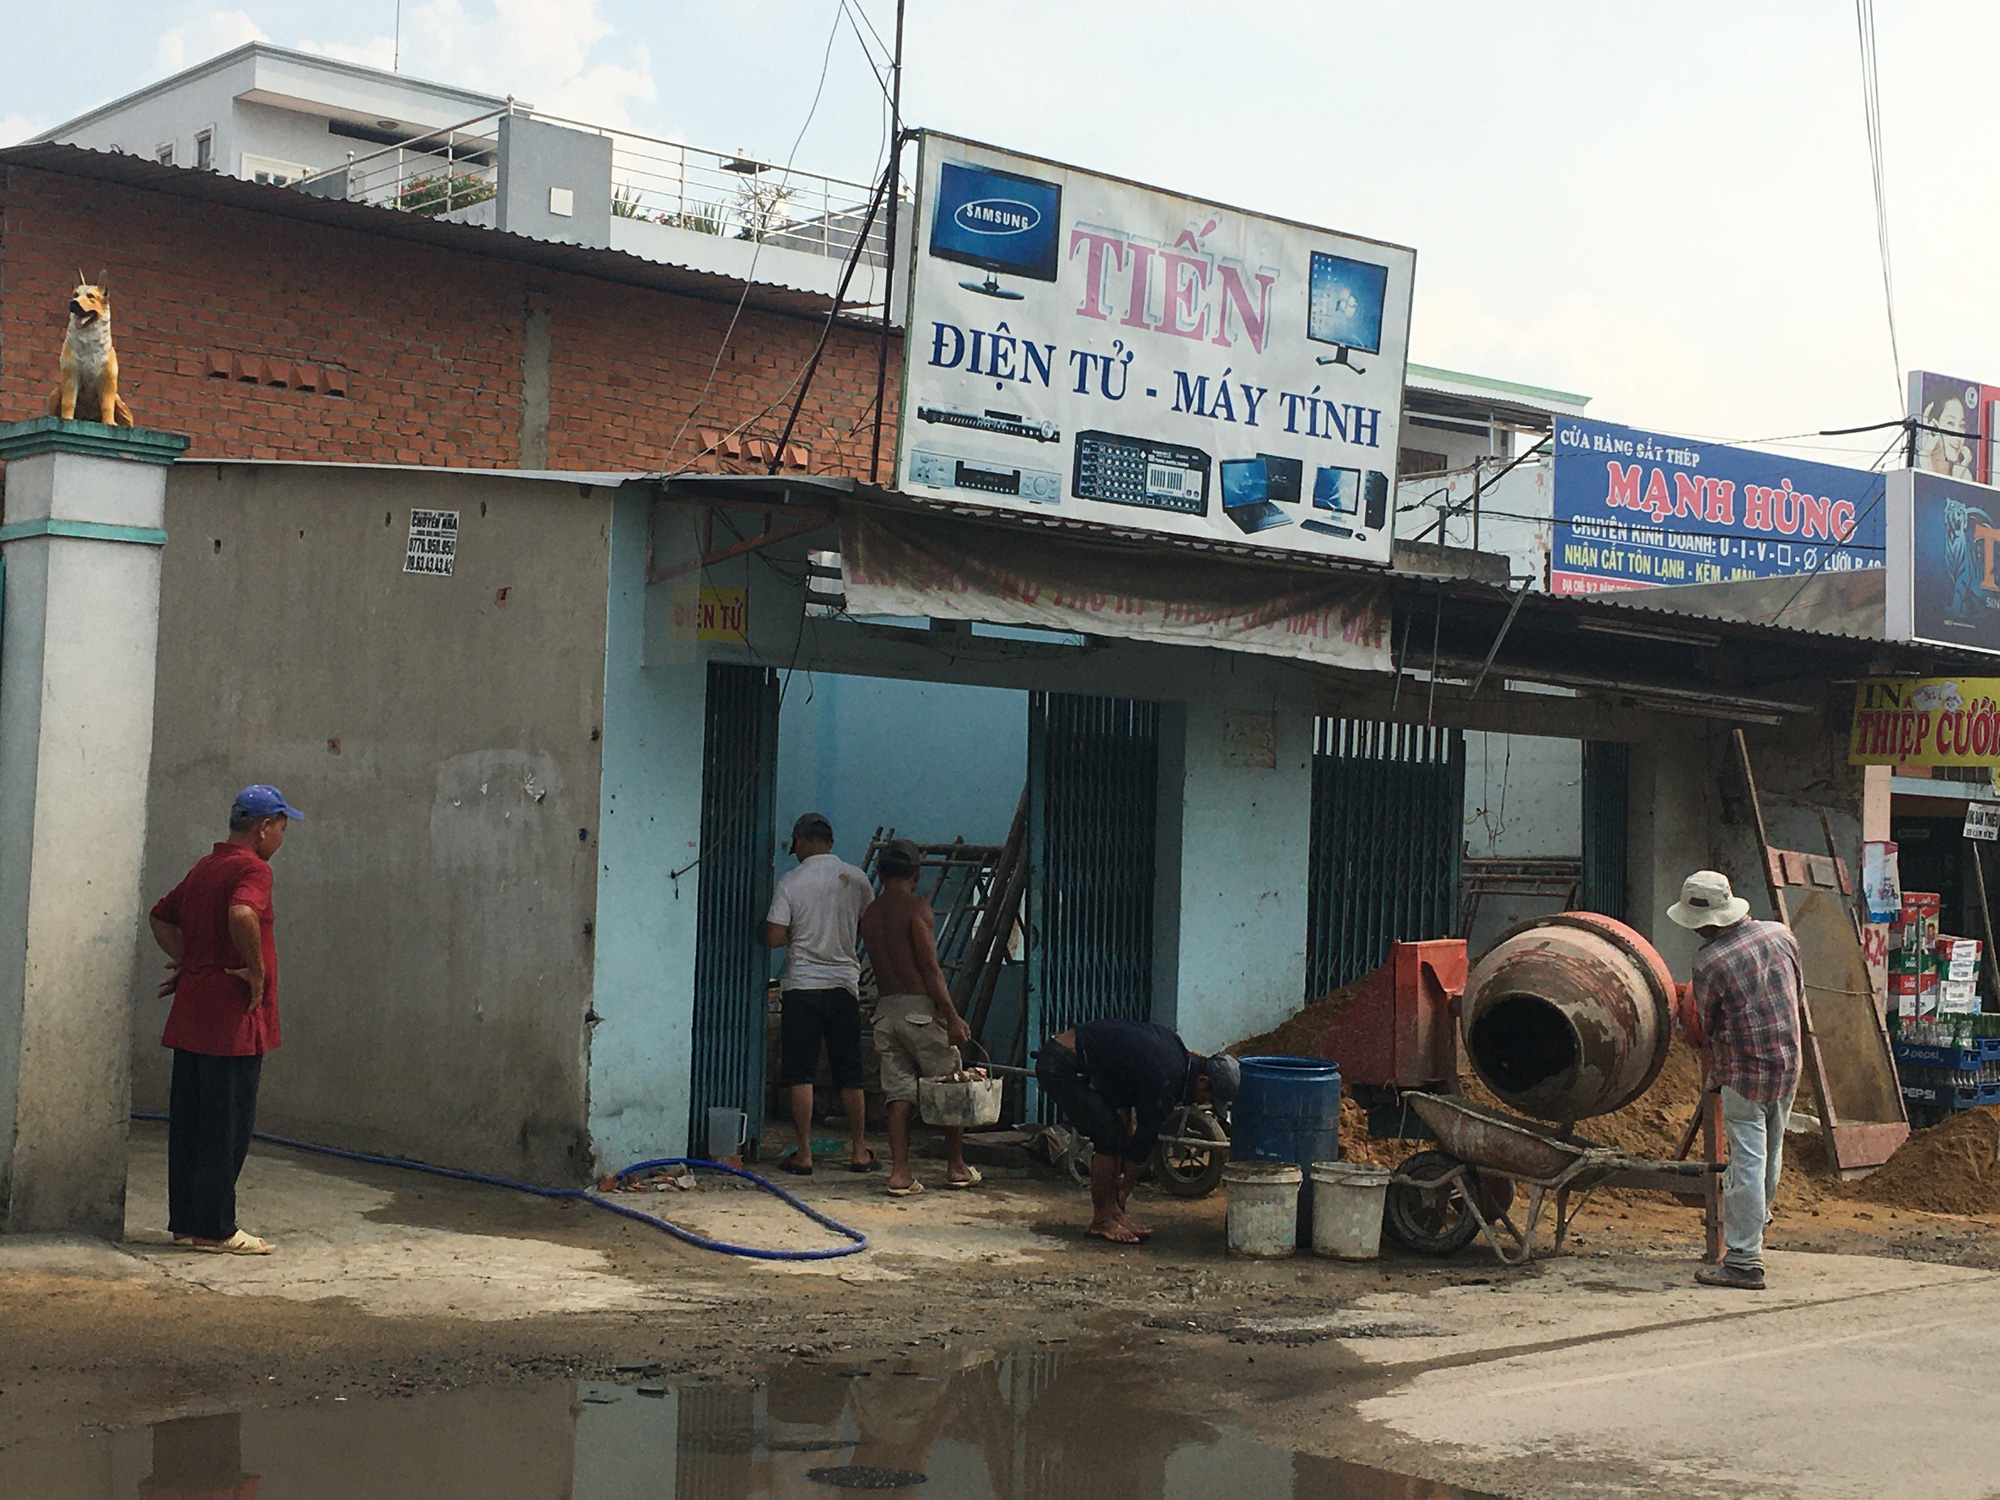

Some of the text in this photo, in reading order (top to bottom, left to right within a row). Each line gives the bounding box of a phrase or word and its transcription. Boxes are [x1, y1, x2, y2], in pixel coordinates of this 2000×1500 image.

[966, 203, 1029, 230] SAMSUNG
[1069, 215, 1278, 355] TIẾN
[927, 321, 1057, 391] ĐIỆN
[1069, 339, 1134, 401] TỬ
[1171, 367, 1268, 427] MÁY
[1280, 385, 1382, 448] TÍNH
[1560, 425, 1700, 468] CỬA HÀNG SẮT THÉP
[1605, 460, 1858, 543] MẠNH HÙNG
[1565, 541, 1598, 571] NHẬN
[1601, 542, 1624, 571] CẮT
[1627, 549, 1652, 575] TÔN
[1654, 556, 1684, 581] LẠNH
[1571, 514, 1628, 541] CHUYÊN
[1631, 522, 1664, 546] KINH
[1824, 550, 1851, 571] LƯỚI
[1863, 683, 1903, 709] IN
[1857, 696, 2000, 762] THIỆP CƯỚI
[1910, 1049, 1939, 1060] pepsi
[1901, 1085, 1937, 1100] PEPSI
